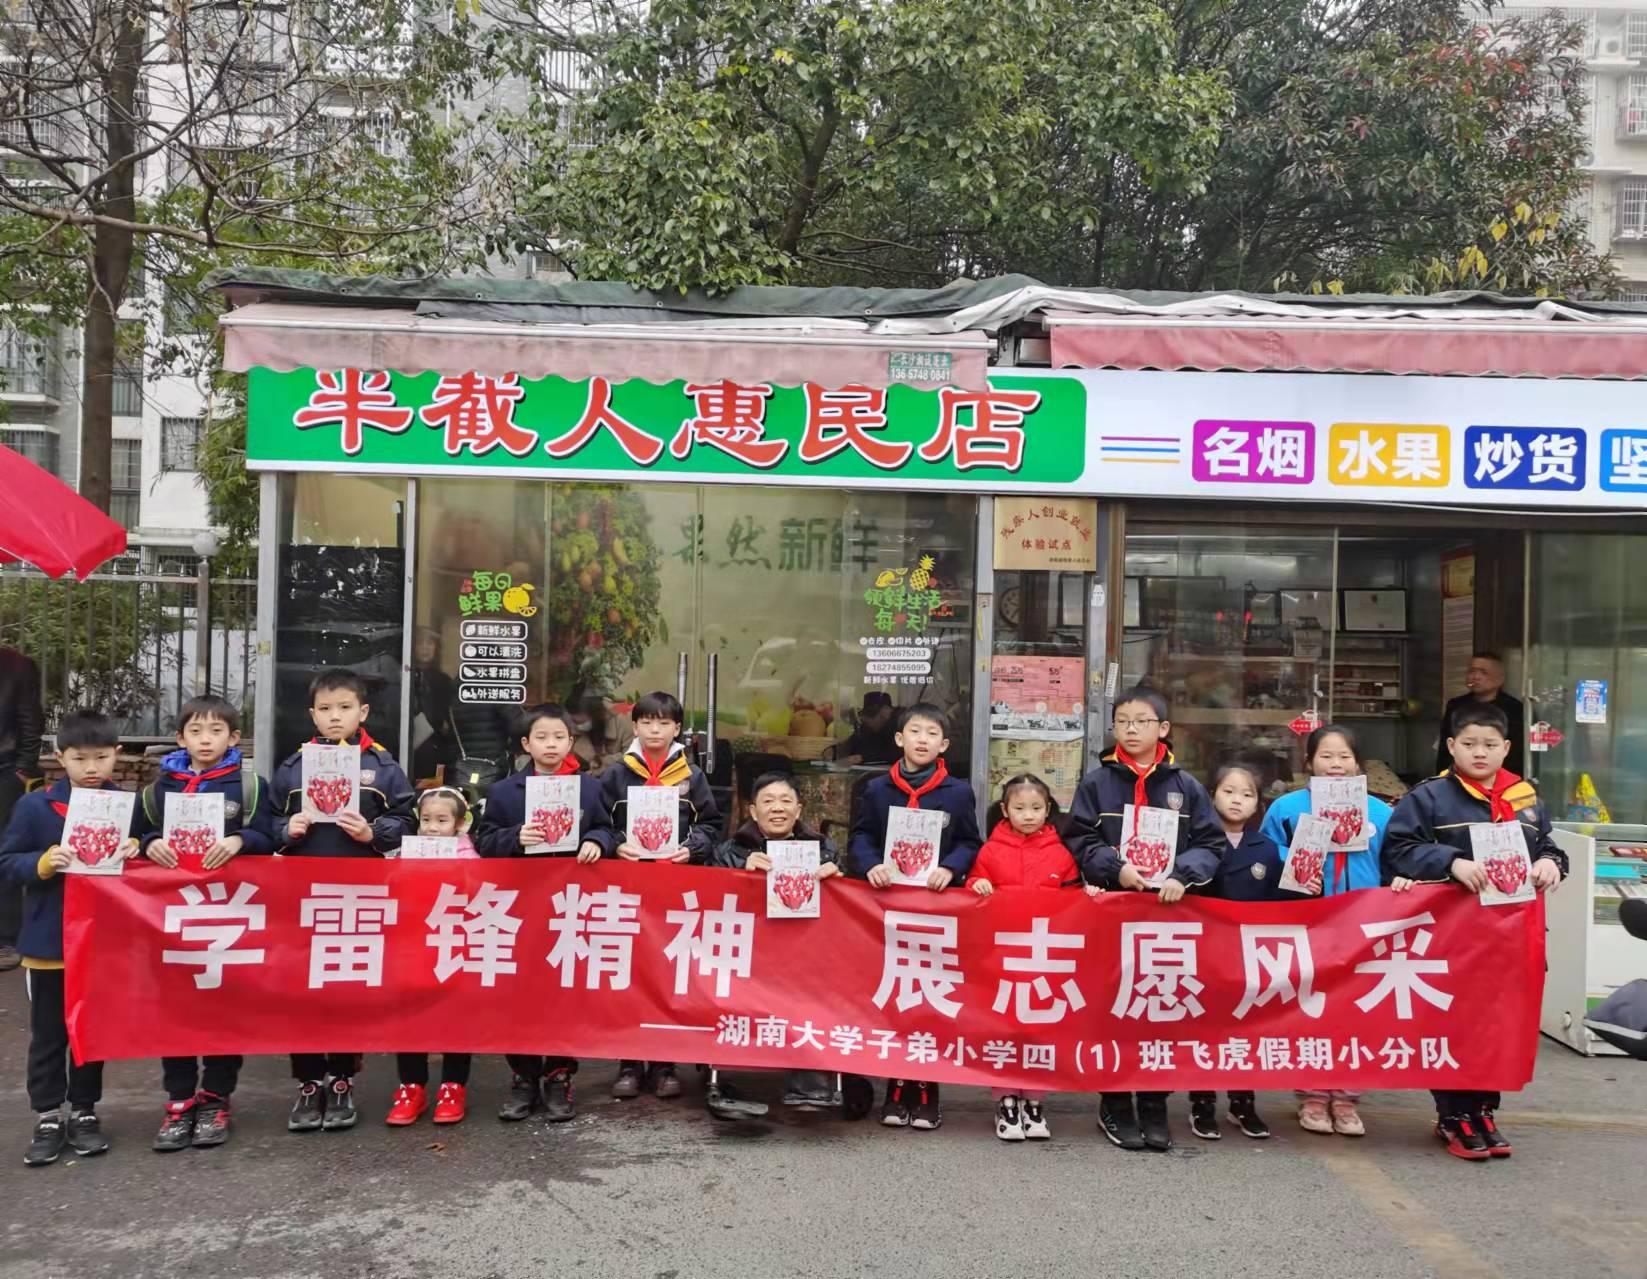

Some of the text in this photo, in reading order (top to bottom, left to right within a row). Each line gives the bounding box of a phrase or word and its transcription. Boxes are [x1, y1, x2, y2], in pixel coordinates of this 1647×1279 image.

[293, 368, 1042, 473] 半截人惠民店
[1202, 426, 1307, 479] 名烟
[1337, 430, 1442, 482] 水果
[1472, 433, 1577, 486] 炒货
[458, 590, 503, 616] 鲜果
[477, 624, 521, 636] 新鲜水果
[162, 881, 1455, 1024] 学雷锋精神 展志愿风采
